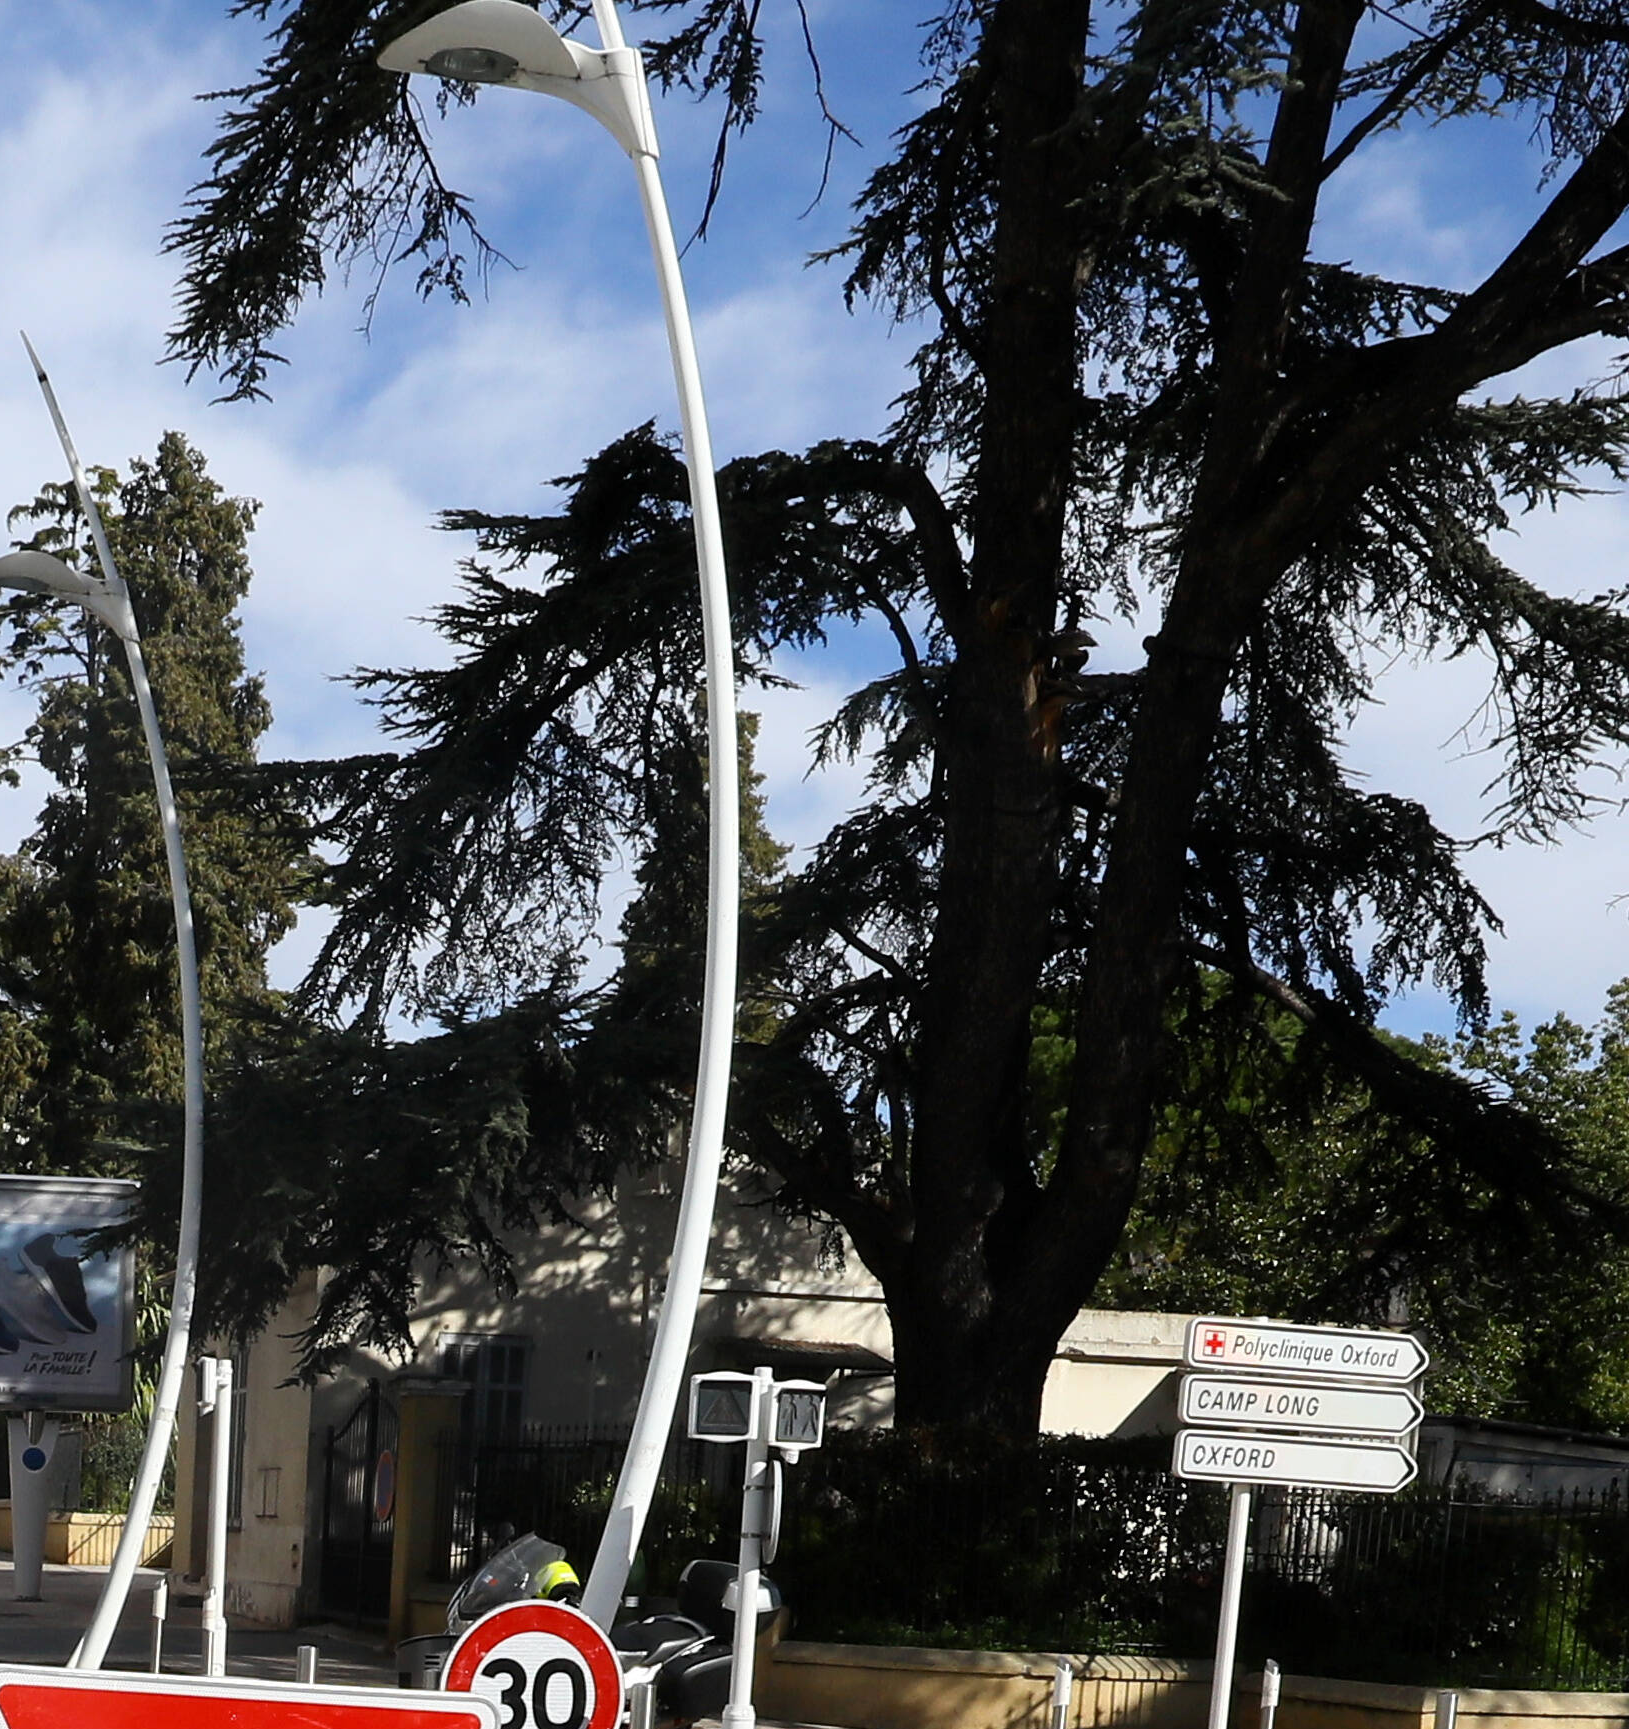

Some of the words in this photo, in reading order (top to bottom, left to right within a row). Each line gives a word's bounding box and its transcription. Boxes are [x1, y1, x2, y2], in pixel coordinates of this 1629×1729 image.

[52, 1351, 88, 1364] TOUTE
[1232, 1335, 1334, 1365] Polyclinique
[1341, 1344, 1399, 1368] Oxford
[23, 1362, 38, 1374] LA
[1197, 1389, 1258, 1412] CAMP
[1264, 1394, 1321, 1417] LONG
[1192, 1444, 1276, 1469] OXFORD
